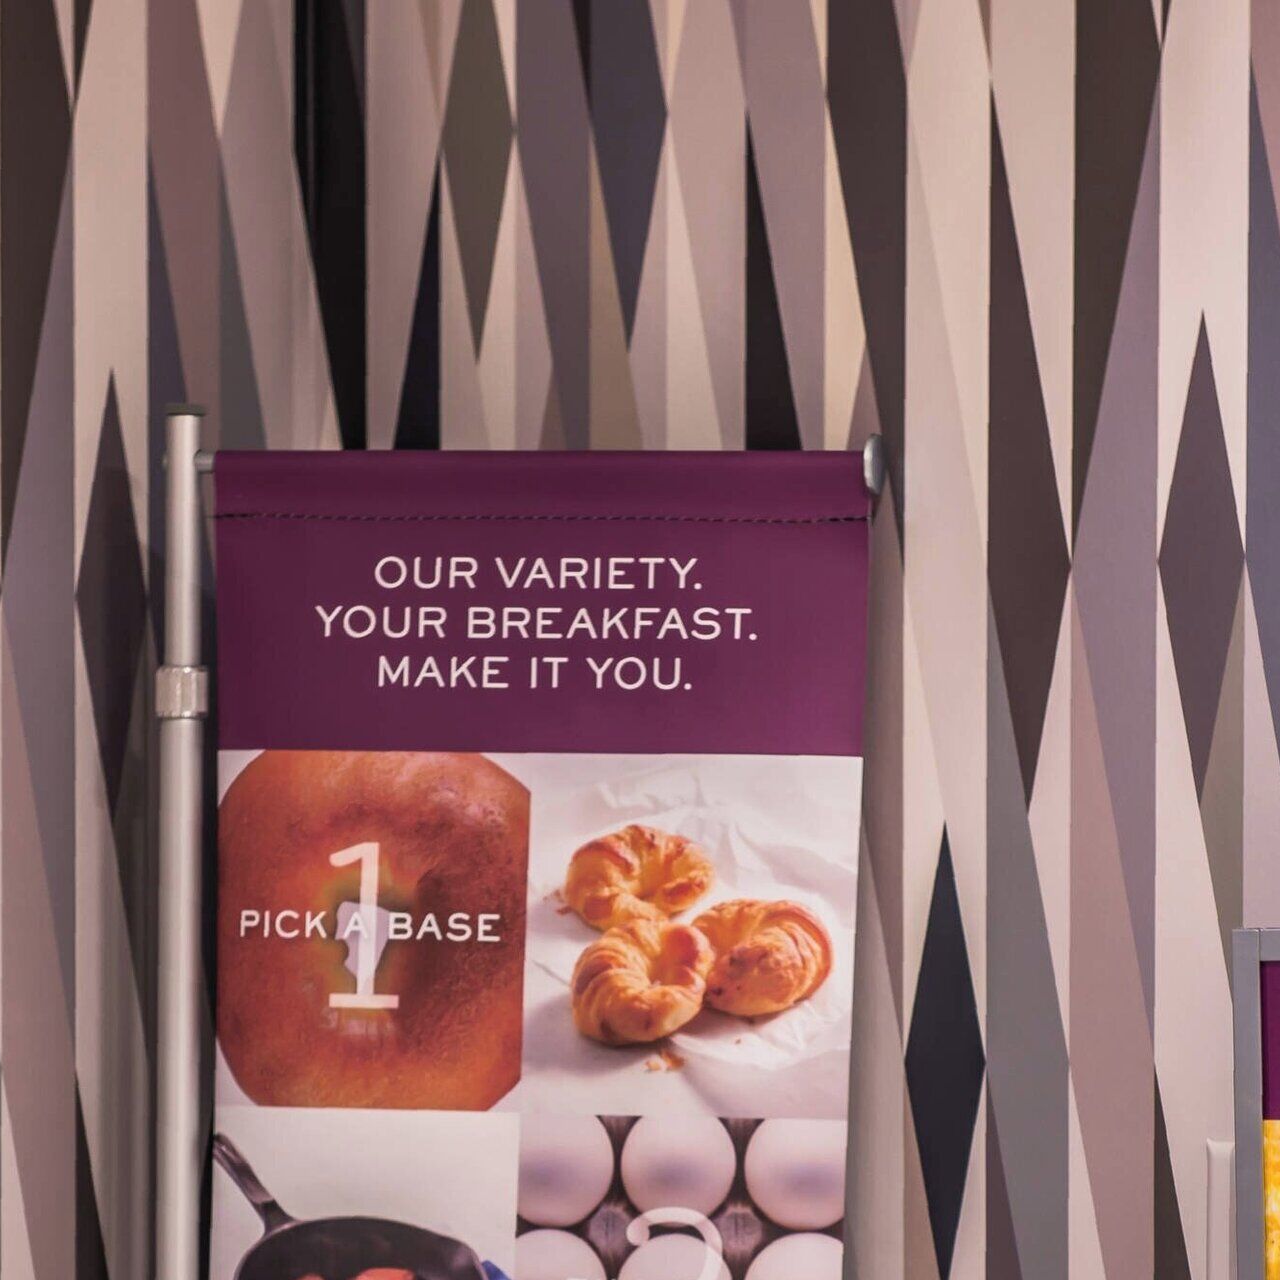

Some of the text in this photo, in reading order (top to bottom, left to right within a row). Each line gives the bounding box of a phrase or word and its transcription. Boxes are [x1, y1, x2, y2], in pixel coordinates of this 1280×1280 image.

[374, 556, 702, 590] OUR VARIETY.
[315, 605, 758, 641] YOUR BREAKFAST.
[377, 655, 692, 691] MAKE IT YOU.
[239, 909, 502, 943] PICK A BASE
[328, 841, 399, 1009] 1
